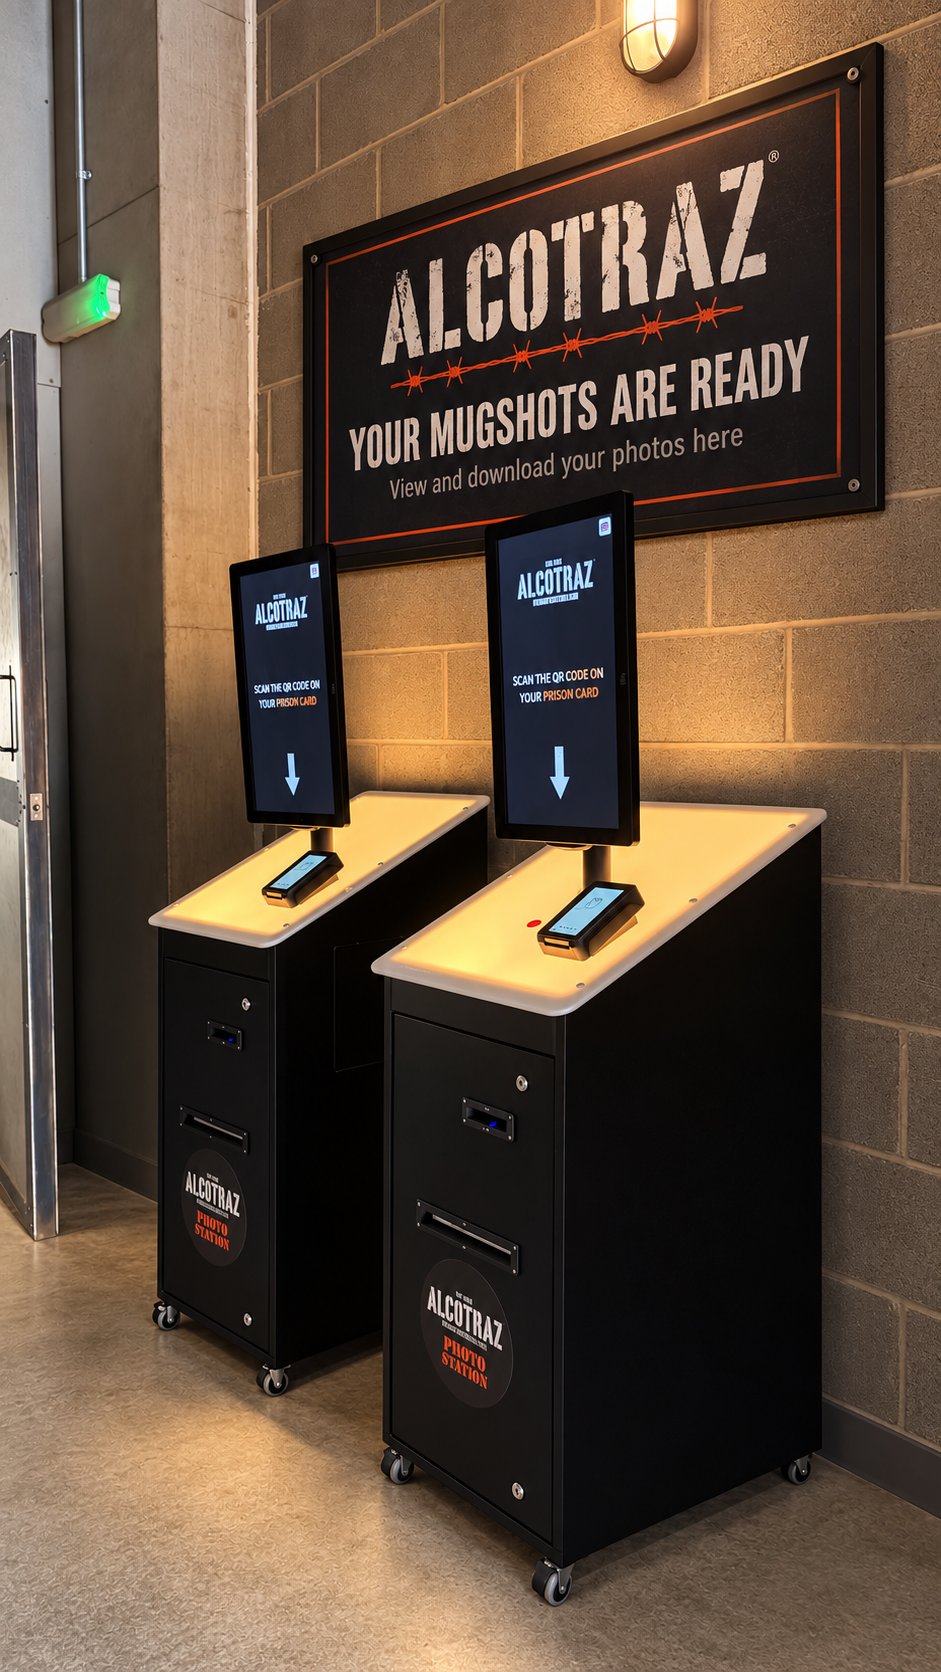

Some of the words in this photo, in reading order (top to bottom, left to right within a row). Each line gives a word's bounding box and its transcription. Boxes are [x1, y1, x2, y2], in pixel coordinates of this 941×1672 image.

[349, 416, 421, 471] YOUR
[430, 380, 598, 458] MUGSHOTS
[610, 363, 677, 426] ARE
[690, 335, 810, 412] READY
[389, 478, 427, 500] View
[432, 469, 462, 492] and
[468, 453, 555, 488] download
[561, 448, 605, 479] your
[612, 436, 685, 471] photos
[693, 427, 744, 453] here
[254, 684, 269, 694] SCAN
[270, 683, 282, 693] THE
[282, 682, 292, 692] QR
[292, 680, 309, 691] CODE
[310, 679, 320, 690] ON
[512, 675, 534, 687] SCAN
[535, 672, 551, 685] THE
[552, 671, 565, 684] QR
[566, 669, 589, 682] CODE
[590, 667, 604, 679] ON
[259, 698, 275, 709] YOUR
[276, 697, 299, 708] PRISON
[299, 695, 317, 706] CARD
[519, 691, 542, 704] YOUR
[543, 688, 574, 702] PRISON
[575, 686, 599, 699] CARD
[185, 1171, 240, 1217] ALCOTRAZ
[195, 1223, 229, 1251] STATION
[197, 1210, 228, 1237] PHOTO
[427, 1286, 503, 1351] ALCOTRAZ
[444, 1335, 486, 1372] PHOTO
[442, 1351, 488, 1390] STATION
